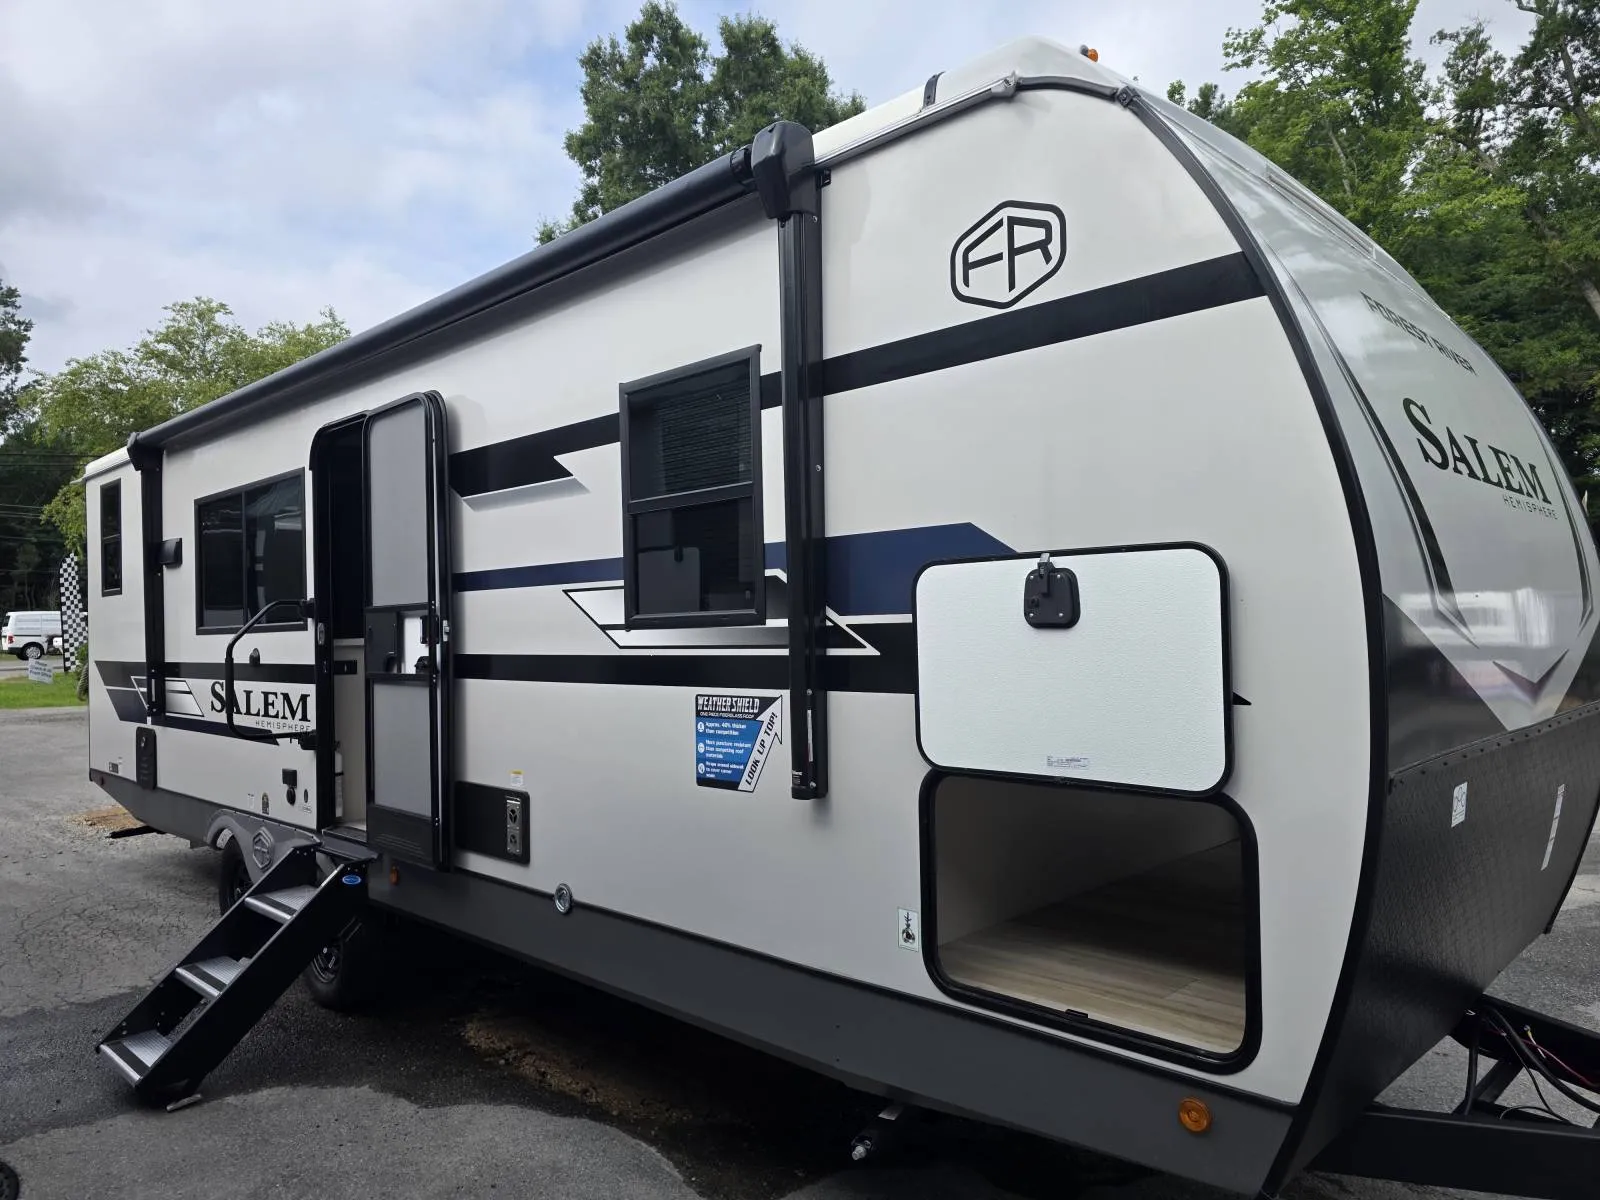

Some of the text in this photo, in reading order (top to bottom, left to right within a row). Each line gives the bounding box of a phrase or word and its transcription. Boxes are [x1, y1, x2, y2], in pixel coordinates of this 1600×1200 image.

[1359, 290, 1478, 377] FOREST RIVER
[1402, 397, 1552, 505] SALEM
[1502, 494, 1558, 520] HEMISPHERE
[210, 680, 311, 722] SALEM
[255, 720, 311, 732] HEMISPHERE
[744, 712, 778, 786] LOOK UP TOP!
